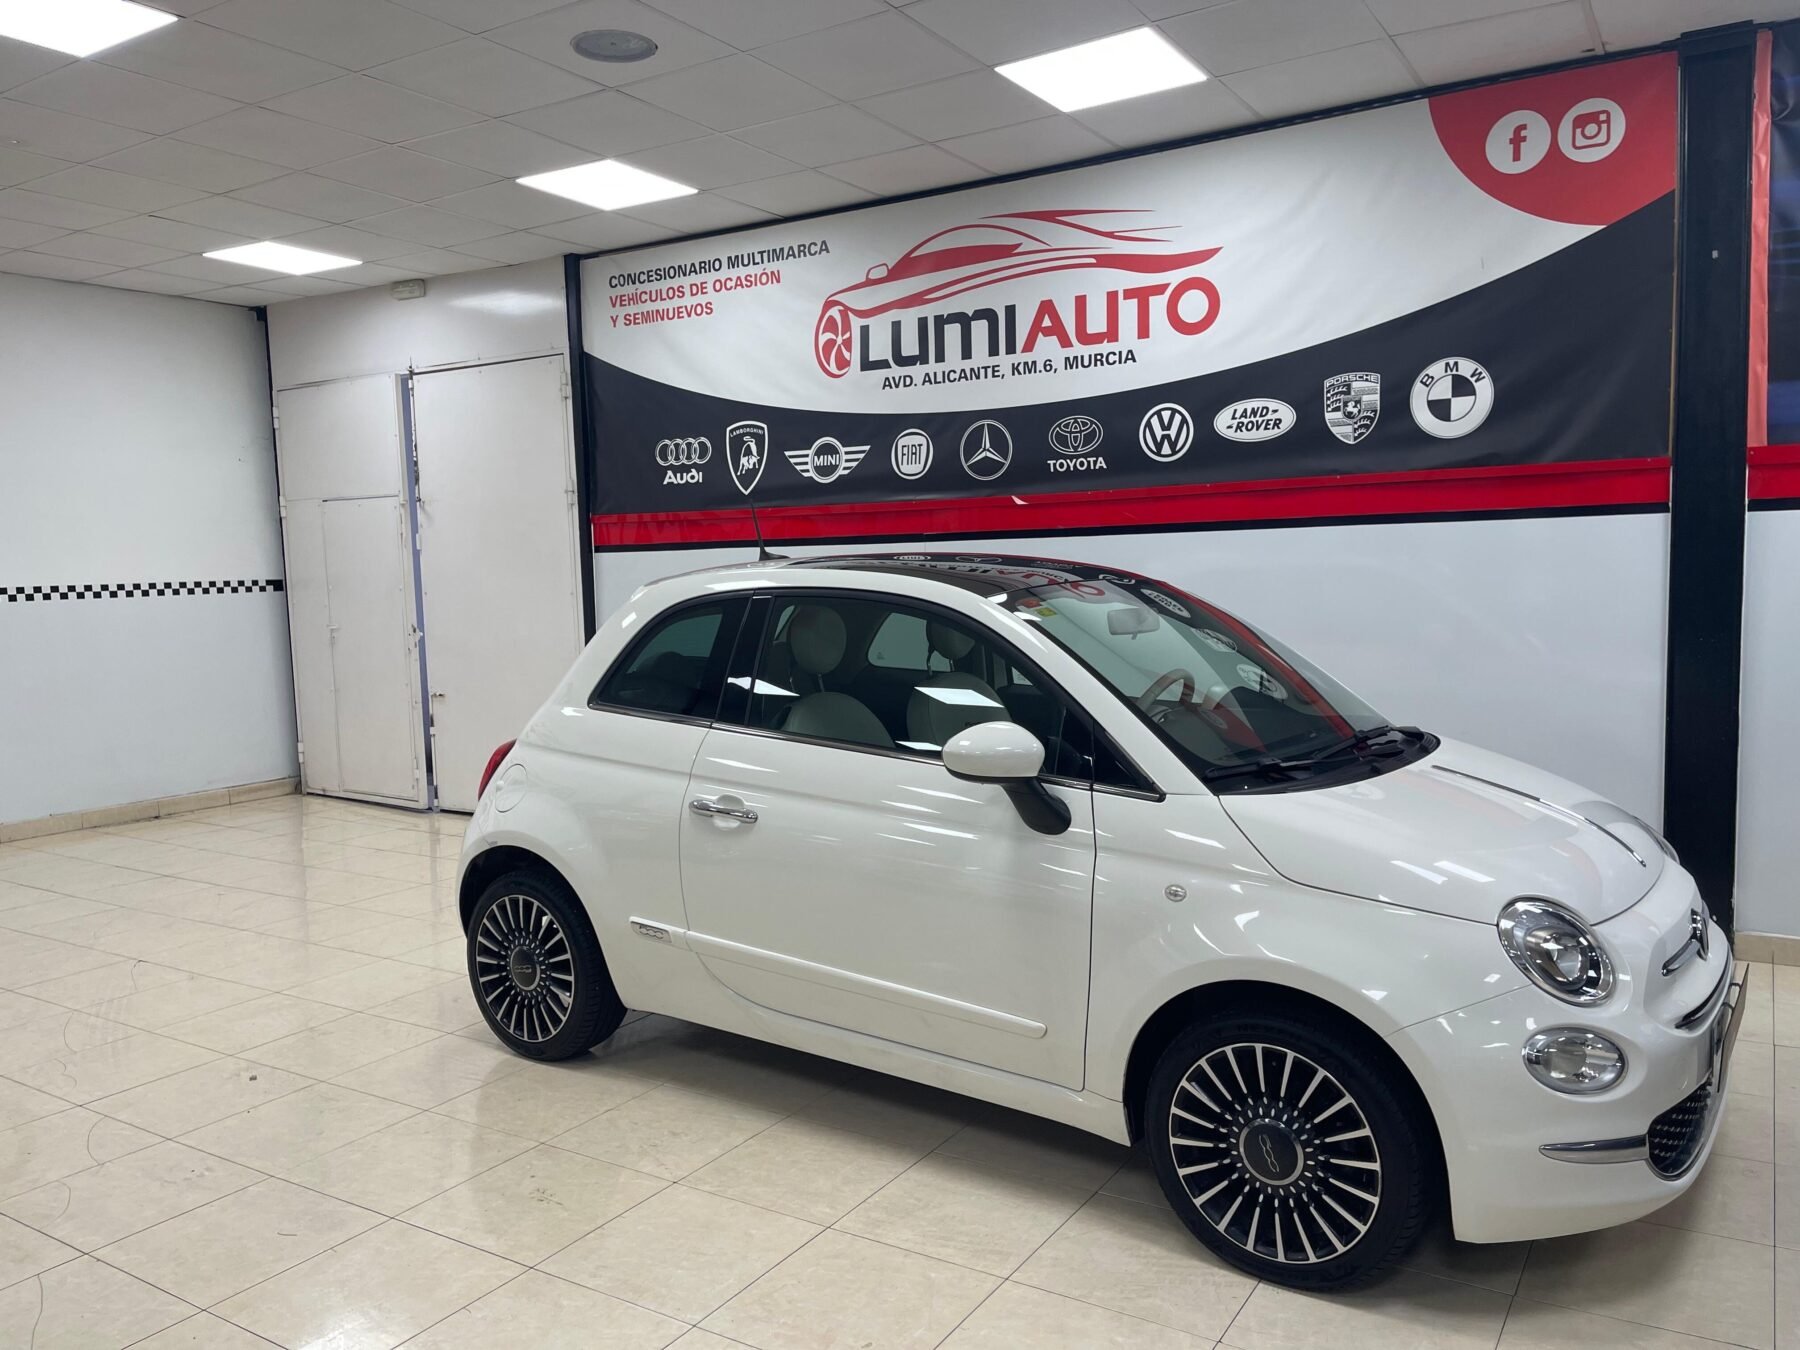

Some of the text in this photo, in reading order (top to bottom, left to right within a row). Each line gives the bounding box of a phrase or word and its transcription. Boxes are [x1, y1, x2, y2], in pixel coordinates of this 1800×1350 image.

[608, 240, 831, 288] CONCESIONARIO MULTIMARCA
[609, 268, 781, 308] VEHÍCULOS DE OCASIÓN
[609, 301, 714, 328] Y SEMINUEVOS
[881, 349, 1137, 391] AVD. ALICANTE, KM.6, MURCIA
[1419, 360, 1487, 388] BMW
[1326, 373, 1379, 388] PORSCHE
[1231, 405, 1270, 421] LAND
[729, 427, 764, 438] LAMBORGHINI
[1234, 417, 1283, 433] ROVER
[813, 453, 840, 467] MINI
[901, 443, 924, 466] FIAT
[1047, 457, 1107, 472] TOYOTA
[663, 468, 703, 485] Audi
